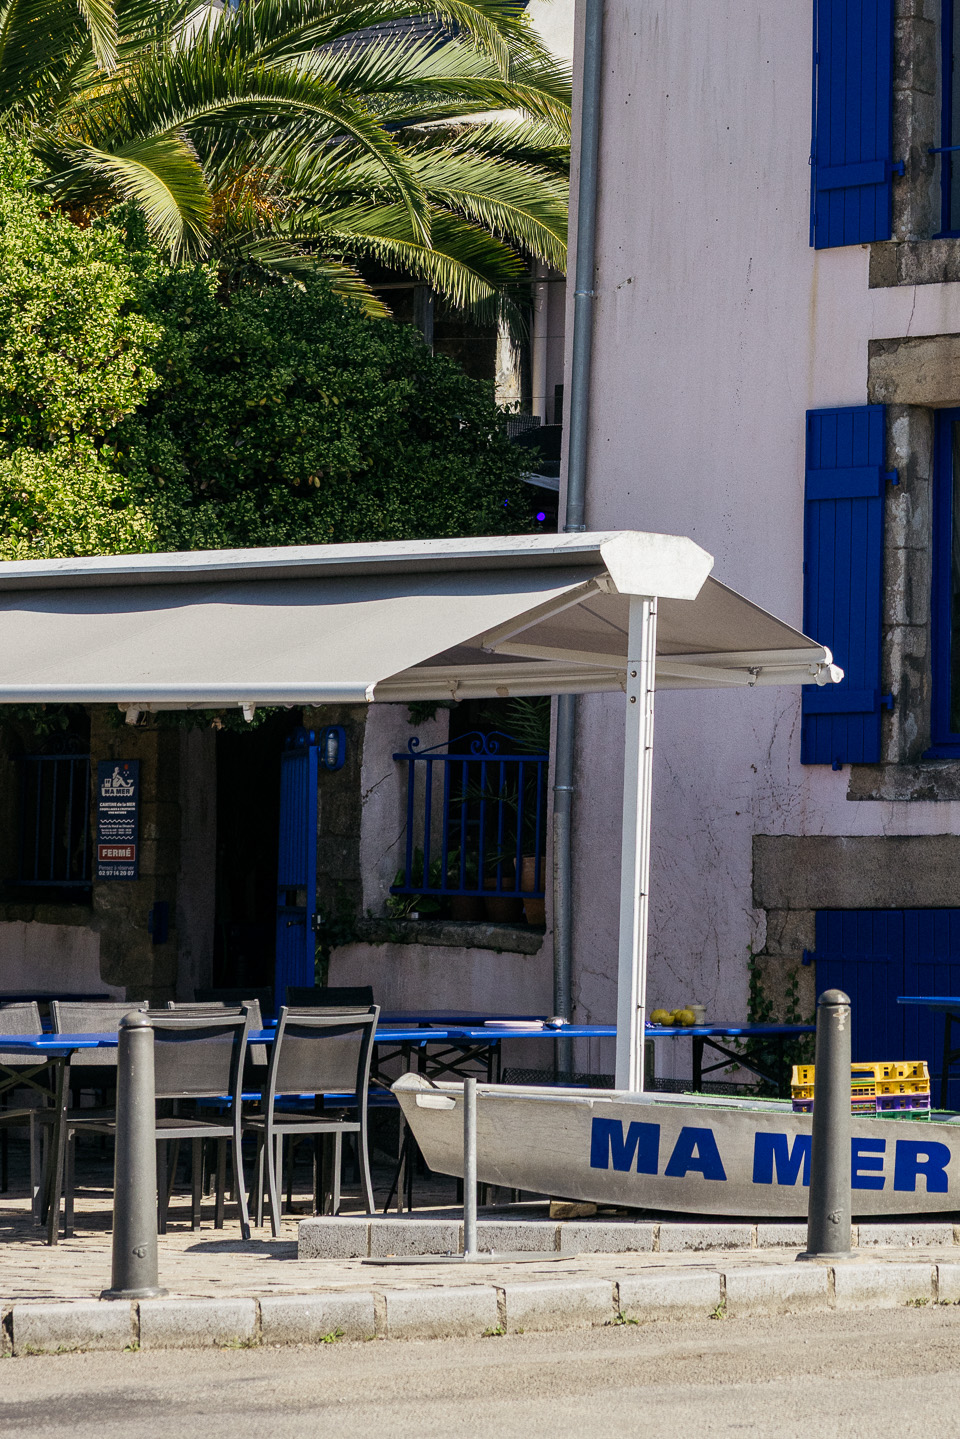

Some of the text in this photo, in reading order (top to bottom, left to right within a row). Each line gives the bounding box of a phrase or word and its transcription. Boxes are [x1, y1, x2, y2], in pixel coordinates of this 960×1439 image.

[102, 847, 131, 857] FERMÉ
[590, 1117, 951, 1194] MA MER
